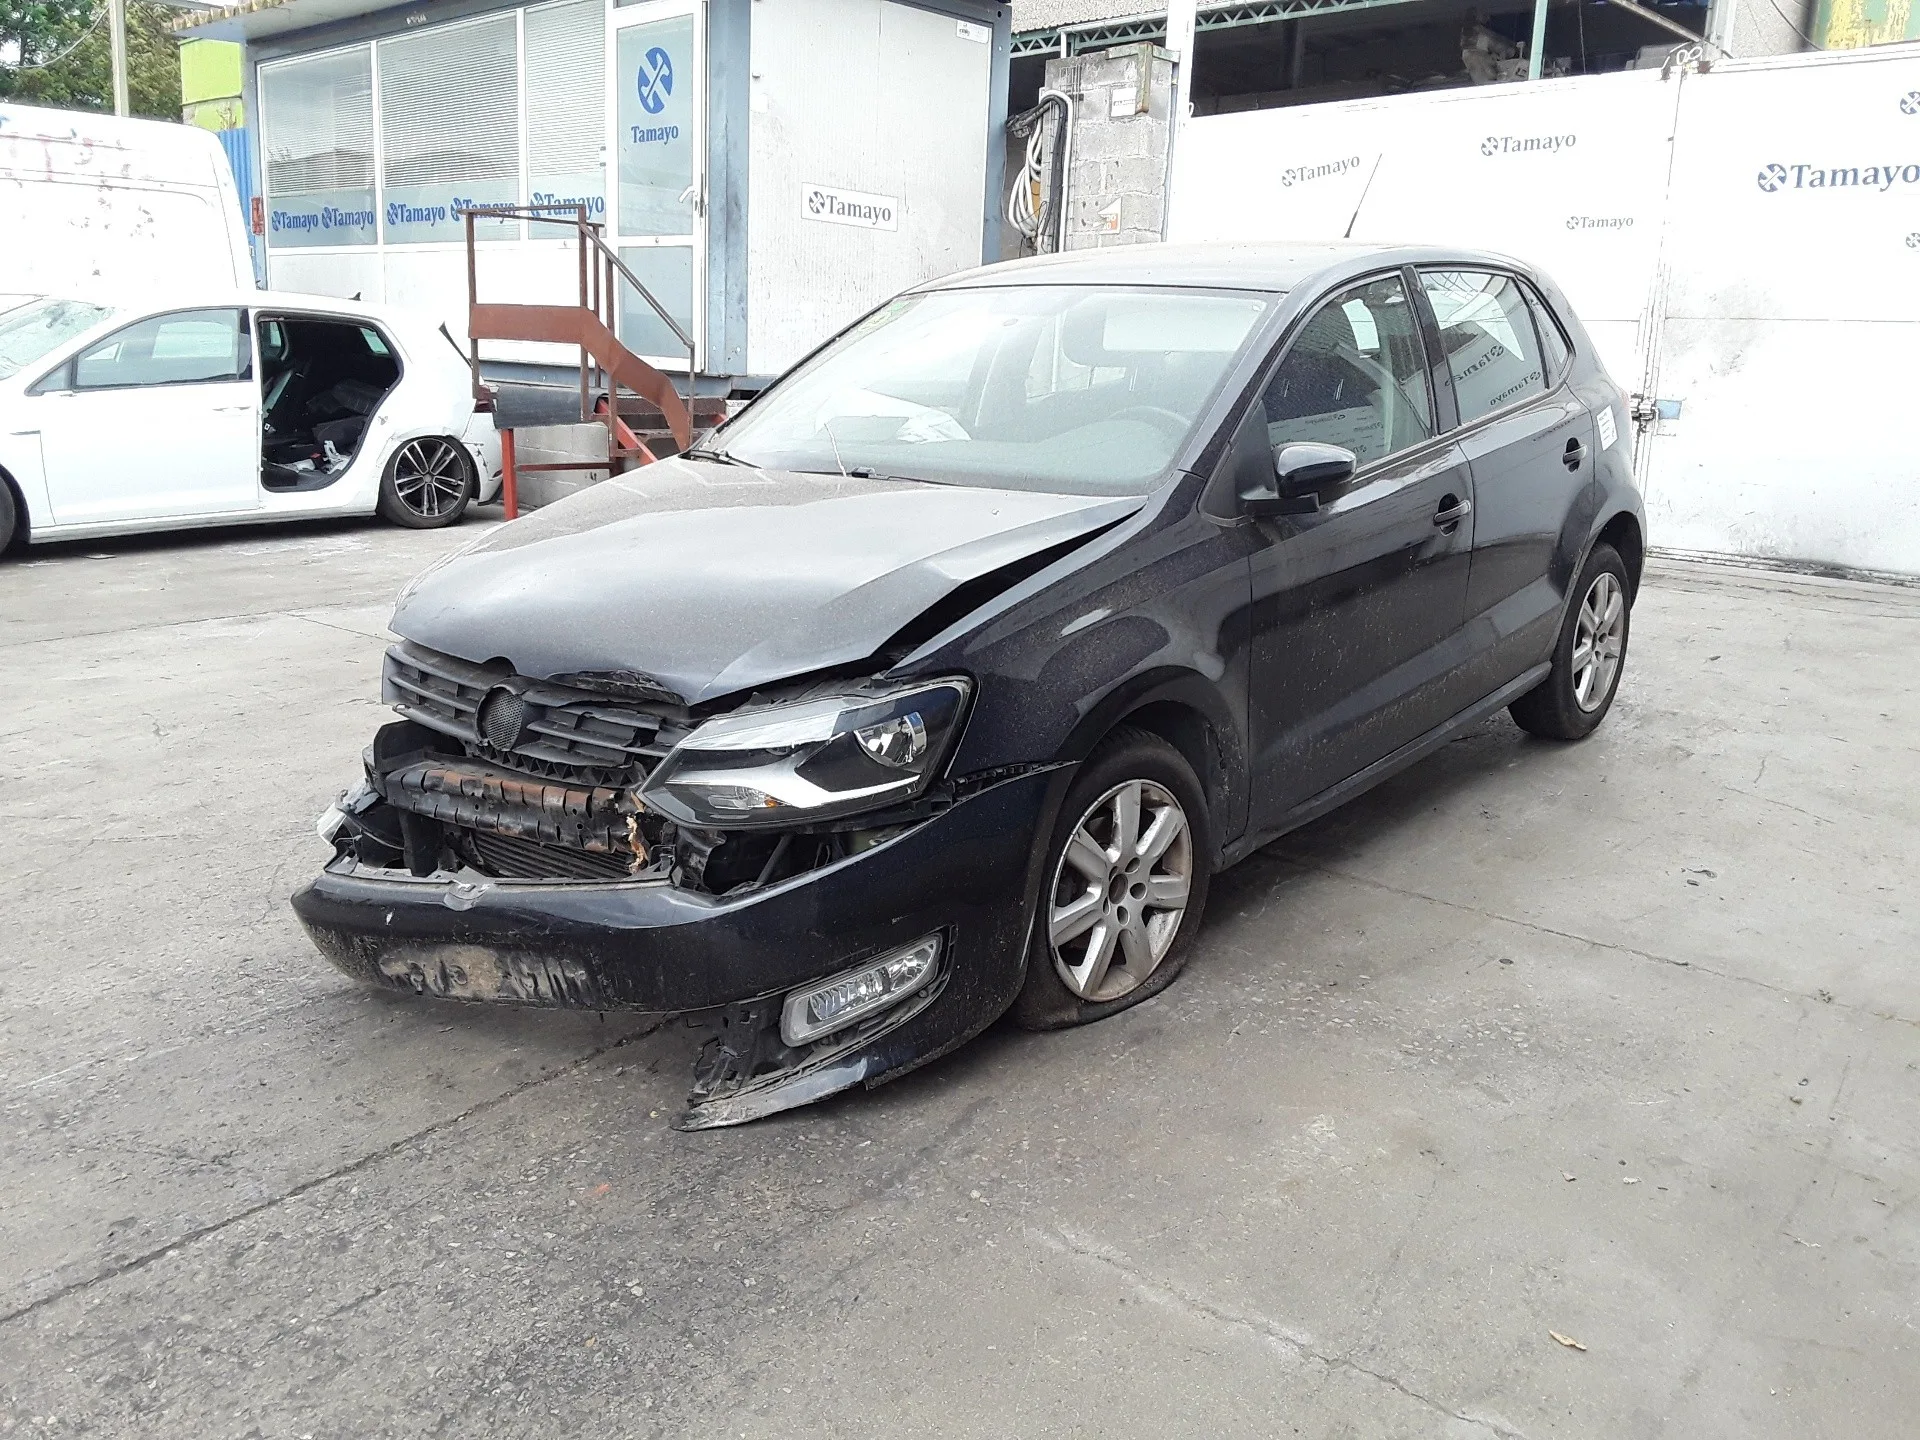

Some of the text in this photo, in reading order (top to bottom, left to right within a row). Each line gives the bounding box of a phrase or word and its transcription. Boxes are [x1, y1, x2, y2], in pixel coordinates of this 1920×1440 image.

[631, 125, 679, 146] Tamayo
[1500, 133, 1576, 154] Tamayo
[1296, 156, 1360, 181] Tamayo
[1790, 164, 1920, 192] Tamayo
[332, 208, 374, 230] Tamayo
[398, 203, 446, 227] Tamayo
[826, 194, 892, 226] Tamayo
[281, 211, 318, 232] Tamayo
[1580, 216, 1634, 230] Tamayo
